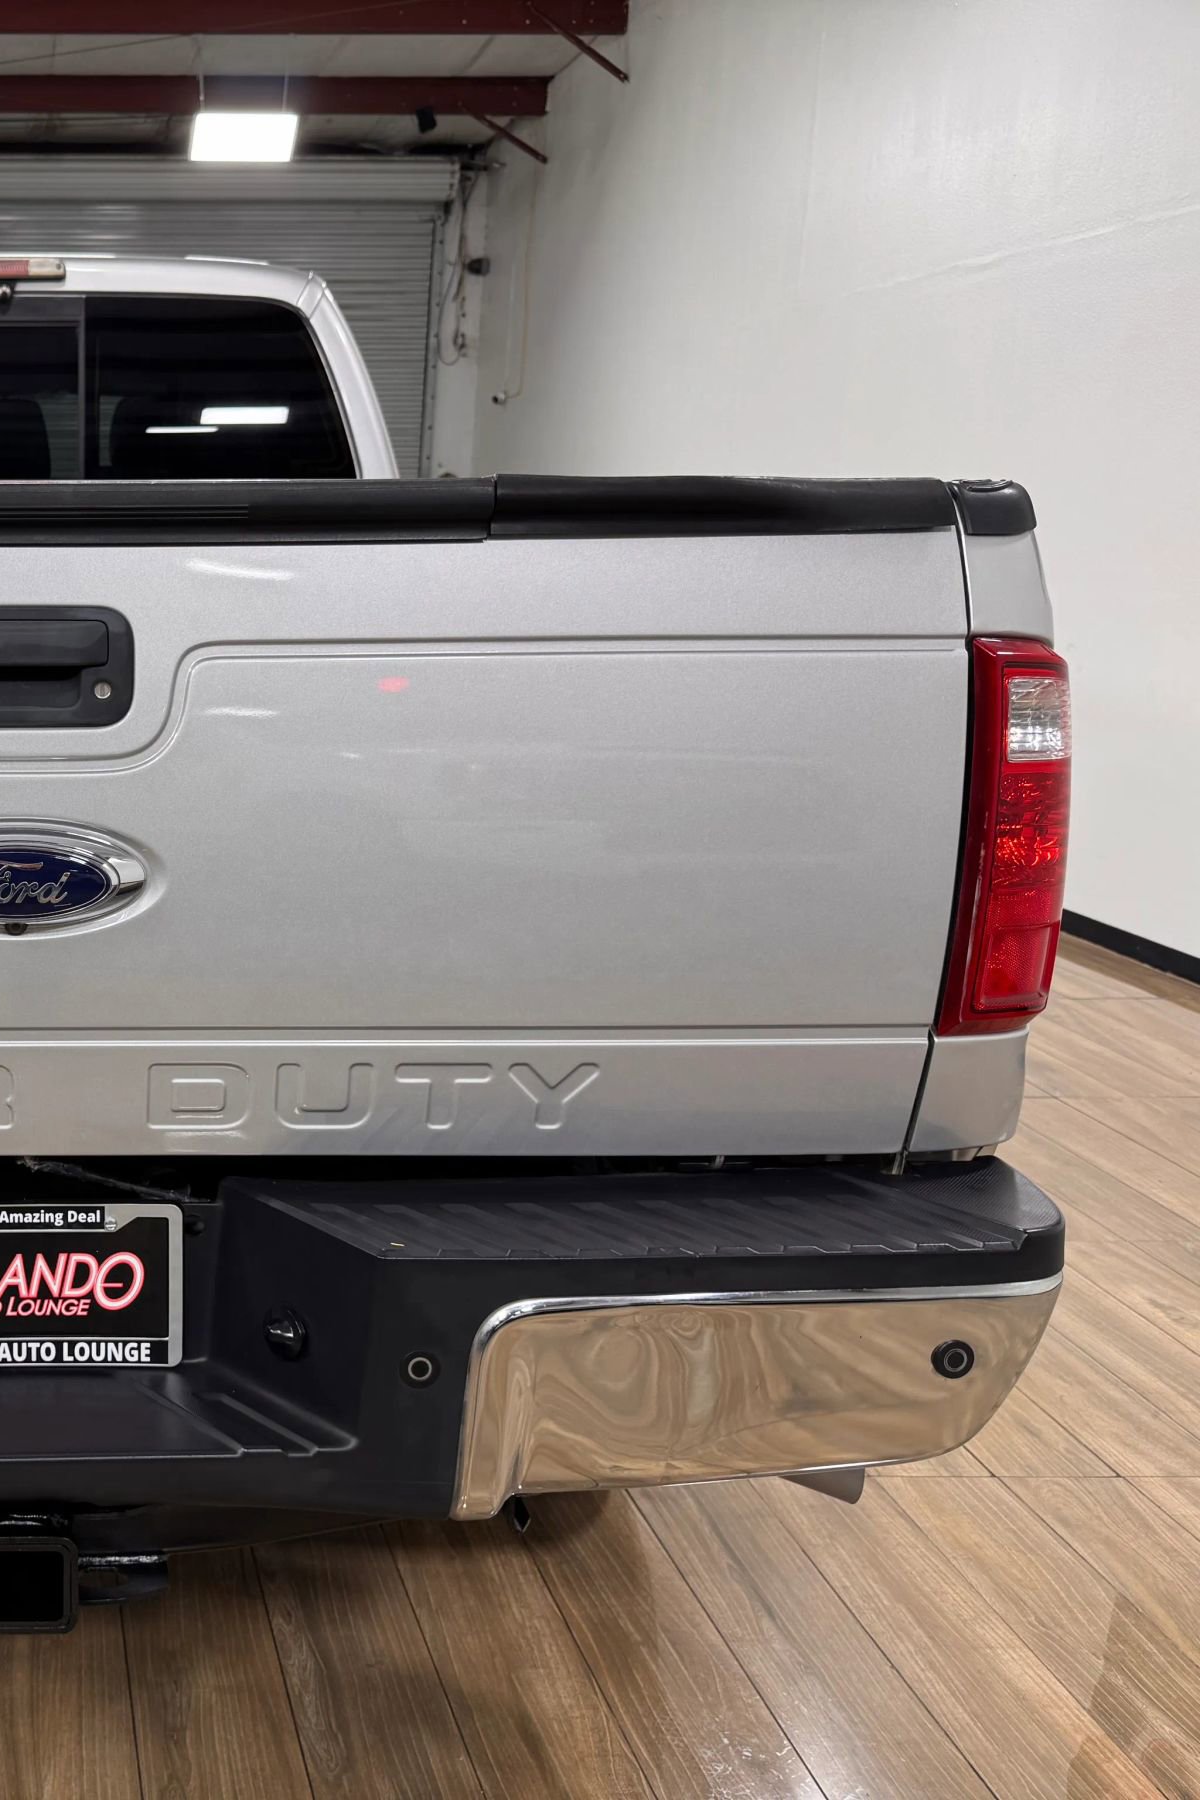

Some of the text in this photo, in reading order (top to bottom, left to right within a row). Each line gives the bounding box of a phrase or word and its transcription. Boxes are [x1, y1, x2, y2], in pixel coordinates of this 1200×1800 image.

[146, 1062, 600, 1130] DUTY
[68, 1209, 101, 1224] Deal
[5, 1296, 92, 1317] LOUNGE
[62, 1342, 151, 1363] LOUNGE
